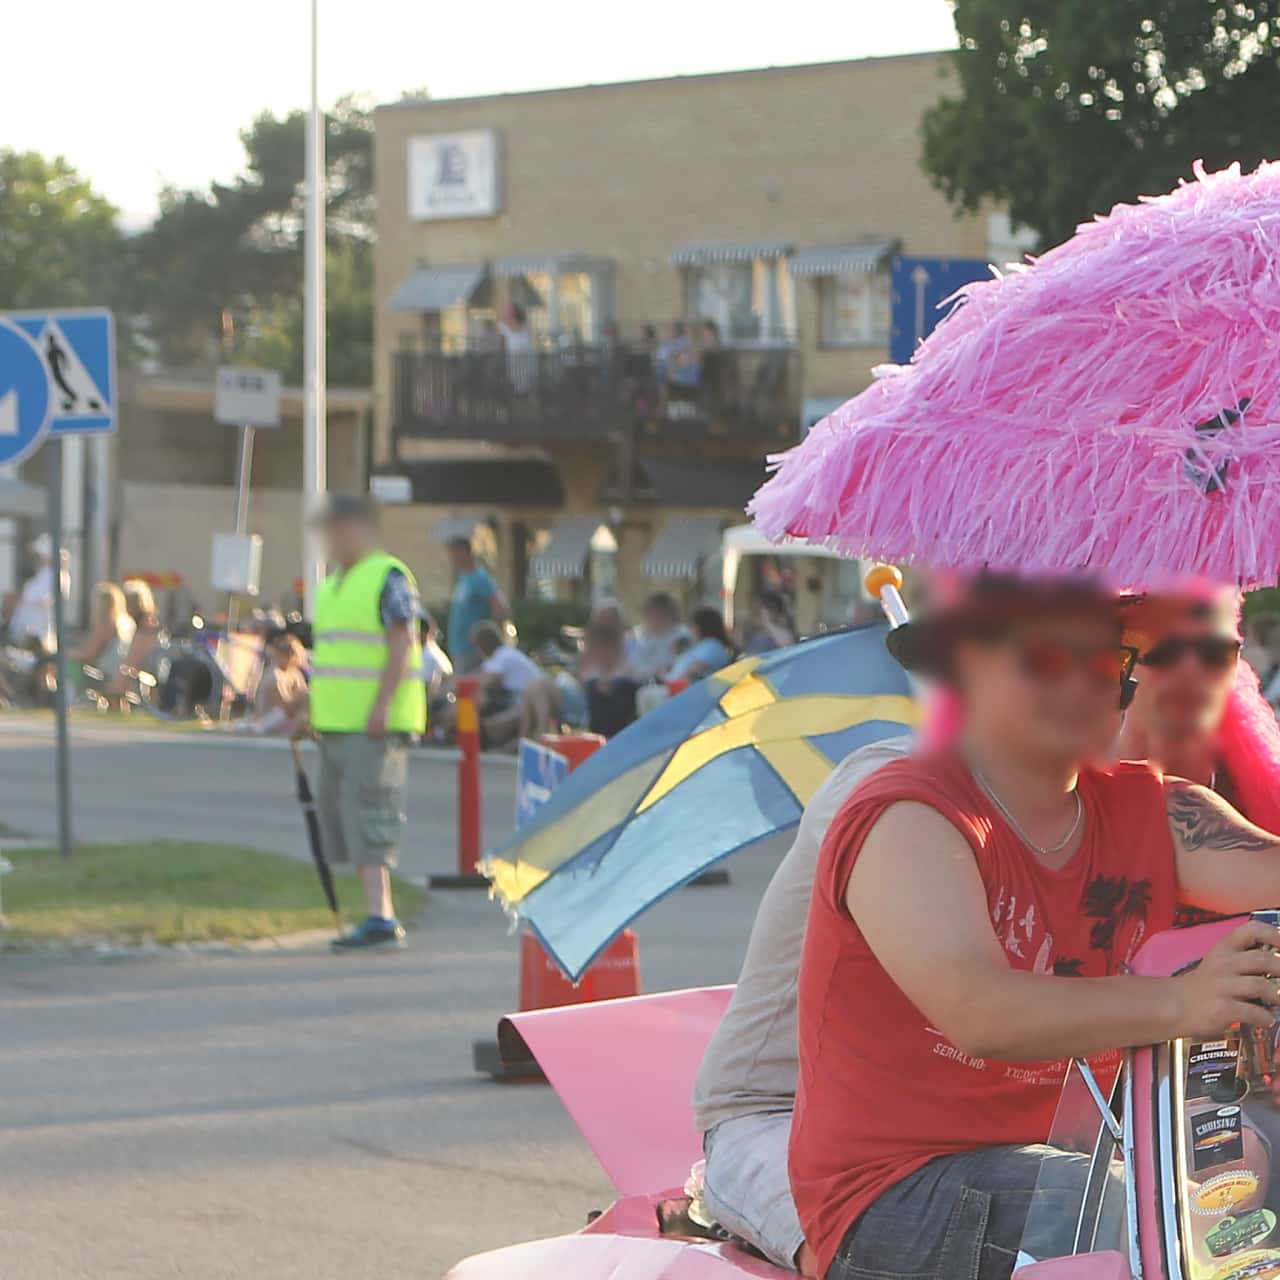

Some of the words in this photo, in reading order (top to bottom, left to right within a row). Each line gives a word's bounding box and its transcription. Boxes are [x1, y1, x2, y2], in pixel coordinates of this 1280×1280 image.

[932, 1042, 968, 1065] SERIAL
[1189, 1050, 1239, 1063] CRUISING
[1195, 1117, 1238, 1137] CRUISING
